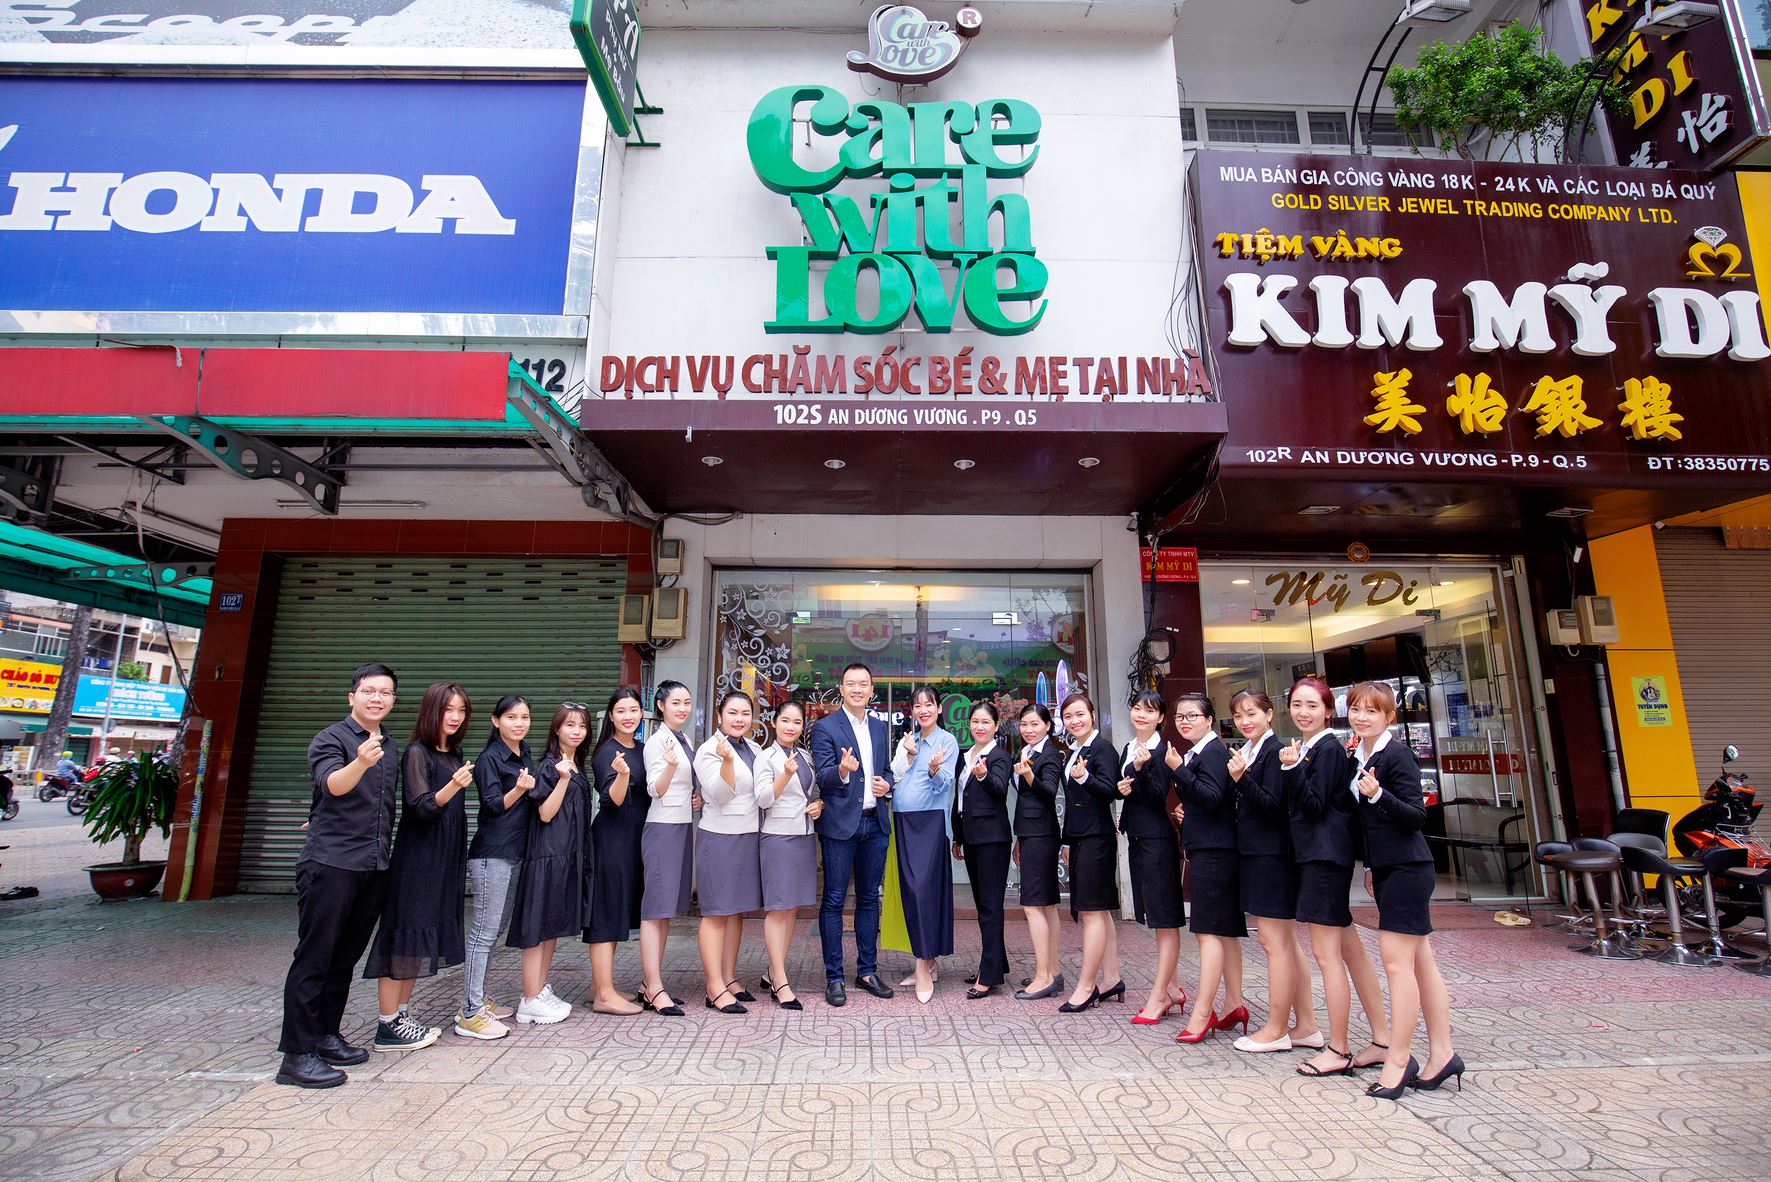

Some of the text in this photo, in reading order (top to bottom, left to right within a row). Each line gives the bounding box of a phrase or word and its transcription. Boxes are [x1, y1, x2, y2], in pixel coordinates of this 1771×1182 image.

[747, 85, 1042, 196] Care
[0, 171, 516, 235] HONDA
[1220, 166, 1258, 183] MUA
[1260, 165, 1297, 185] BÁN
[1300, 169, 1330, 185] GIA
[1333, 167, 1384, 187] CÔNG
[1387, 169, 1436, 188] VÀNG
[1536, 175, 1560, 194] VÀ
[1563, 176, 1600, 196] CÁC
[1605, 181, 1646, 201] LOẠI
[1651, 180, 1677, 199] ĐÁ
[1680, 181, 1717, 200] QUÝ
[790, 164, 1037, 260] with
[1271, 192, 1679, 224] GOLD SILVER JEWEL TRADING COMPANY LTD.
[1215, 226, 1404, 263] TIỆM VÀNG
[764, 246, 1049, 336] Love
[1222, 262, 1771, 362] KIM MỸ DI
[600, 355, 680, 400] DỊCH
[686, 355, 735, 400] VỤ
[742, 344, 847, 394] CHĂM
[854, 345, 921, 394] SÓC
[928, 346, 974, 394] BÉ
[978, 356, 1008, 395] &
[1015, 356, 1069, 402] MẸ
[1136, 349, 1213, 396] NHÀ
[773, 404, 822, 425] 102S
[828, 409, 849, 424] AN
[855, 407, 908, 425] DƯƠNG
[914, 408, 967, 425] VƯƠNG
[981, 409, 1001, 425] P9
[1014, 409, 1037, 425] Q5
[1246, 446, 1293, 463] 102R
[1300, 450, 1330, 464] AN
[1336, 449, 1415, 465] DƯƠNG
[1419, 452, 1498, 467] VƯƠNG
[1146, 562, 1164, 571] KM
[1265, 570, 1419, 613] Mỹ Di
